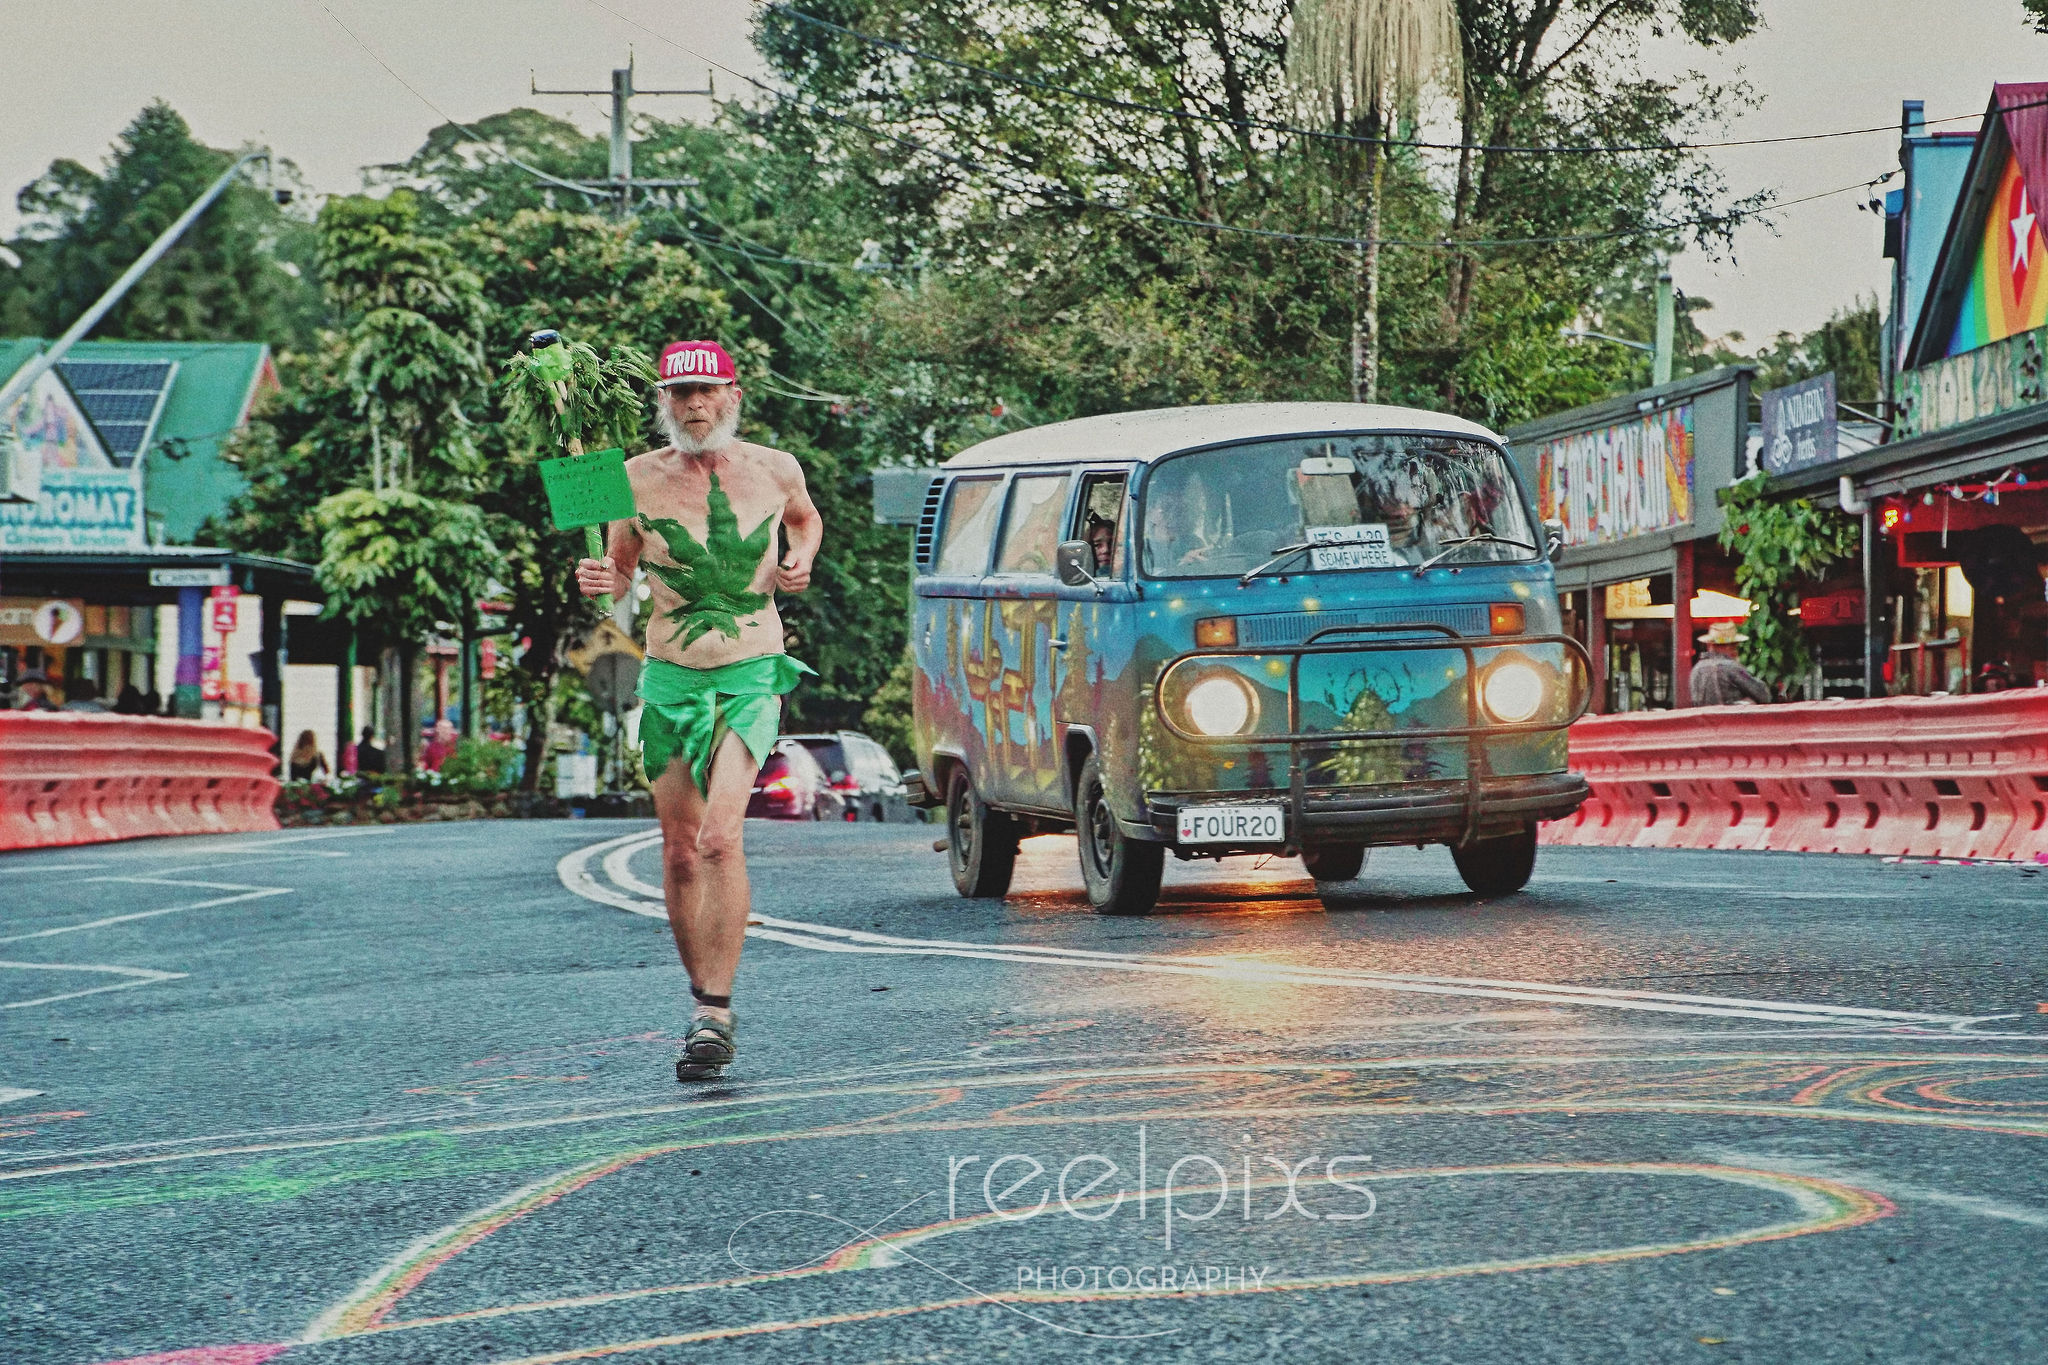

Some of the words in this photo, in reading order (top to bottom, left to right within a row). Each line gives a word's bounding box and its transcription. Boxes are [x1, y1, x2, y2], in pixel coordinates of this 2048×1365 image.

[666, 349, 718, 376] TRUTH
[1552, 422, 1671, 546] EMPORIUM
[1320, 550, 1390, 567] SOMEWHERE
[1194, 815, 1277, 838] FOUR20
